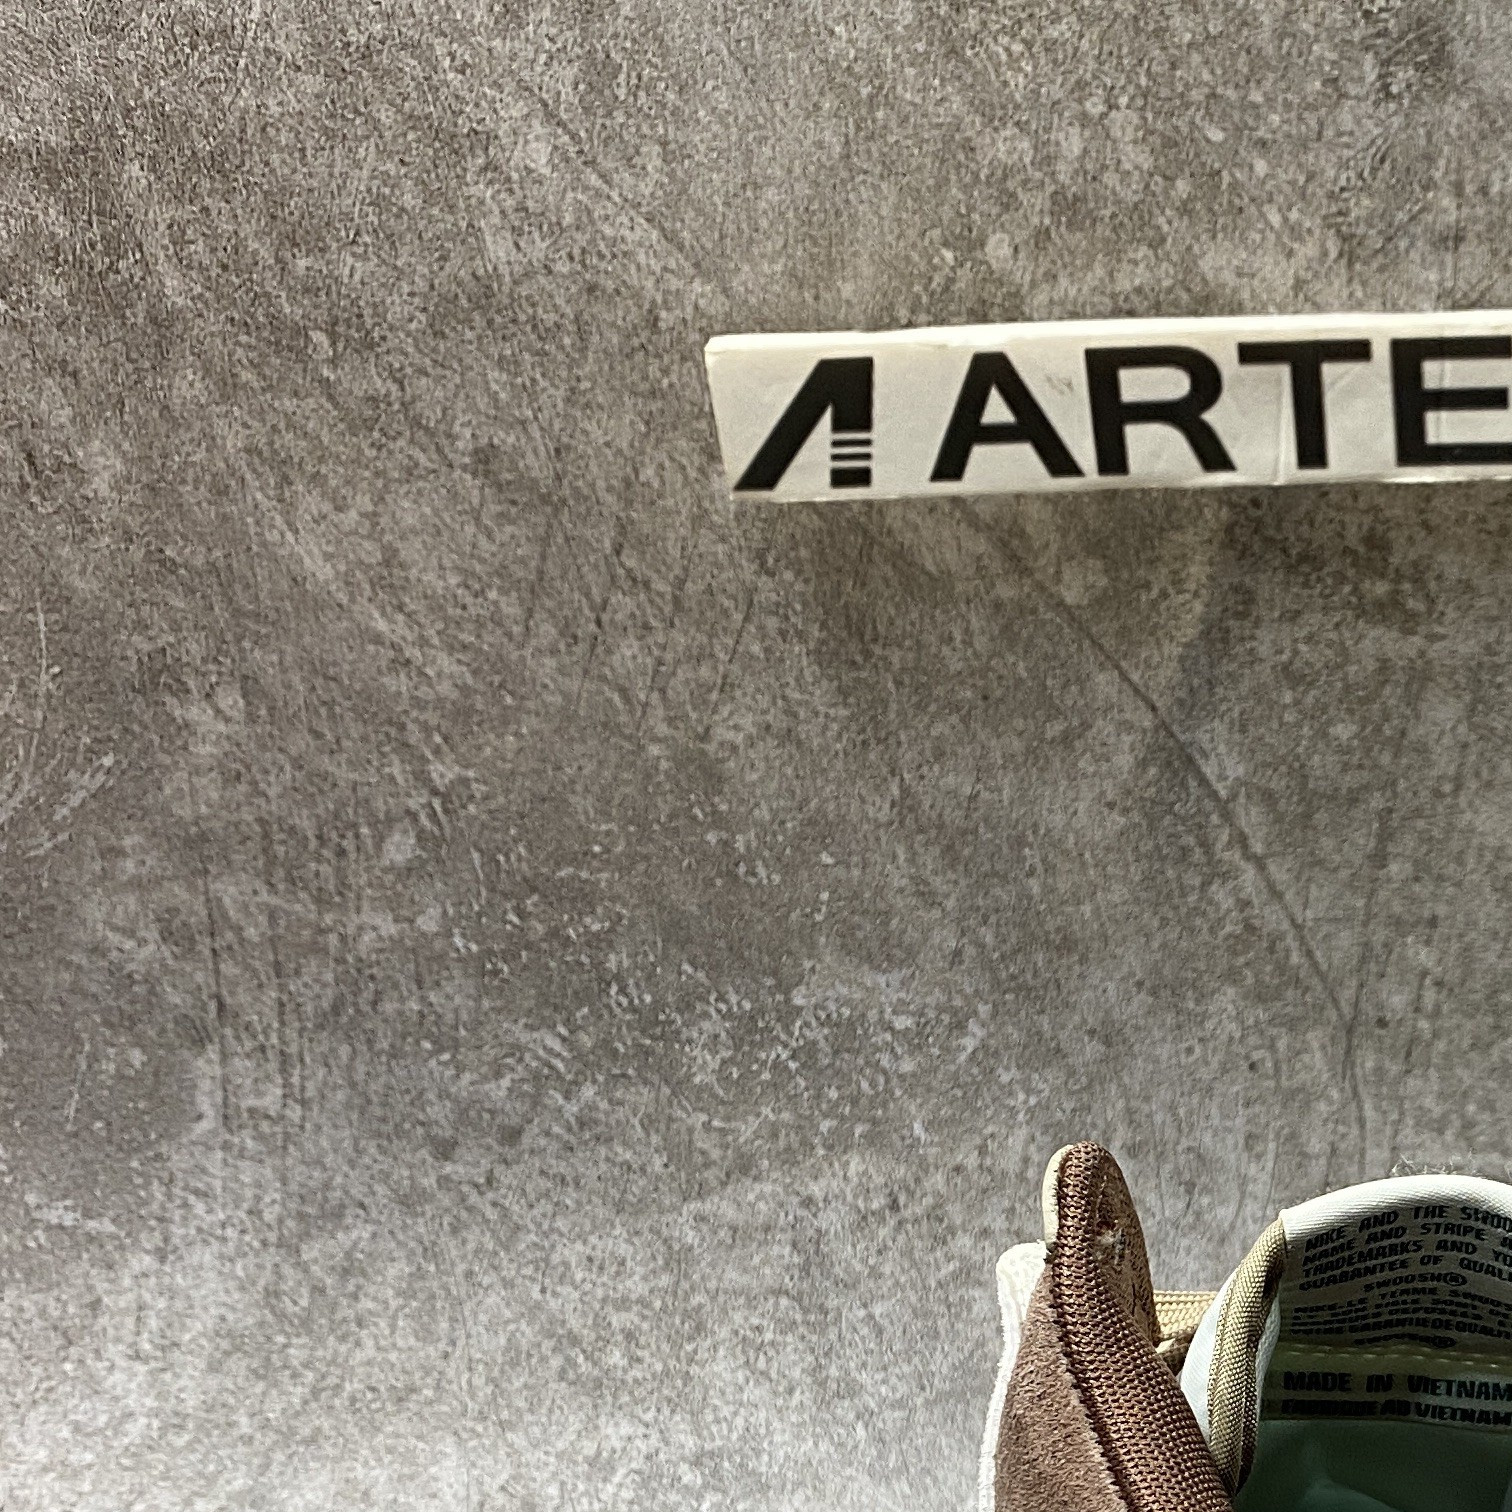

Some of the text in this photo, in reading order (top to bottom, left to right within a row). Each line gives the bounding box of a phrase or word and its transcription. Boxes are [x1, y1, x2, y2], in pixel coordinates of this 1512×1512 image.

[1302, 1238, 1356, 1266] NAME
[1365, 1226, 1407, 1245] AND
[1420, 1222, 1487, 1241] STRIPE
[1305, 1225, 1348, 1252] NIKE
[1359, 1210, 1399, 1232] AND
[1413, 1205, 1452, 1220] THE
[1300, 1258, 1409, 1291] GUARANTEE
[1420, 1254, 1443, 1266] OF
[1303, 1240, 1424, 1278] TRADEMARKS
[1435, 1240, 1477, 1255] AND
[1284, 1371, 1512, 1402] MADE IN VIETNAM
[1415, 1402, 1512, 1426] VIETNAM
